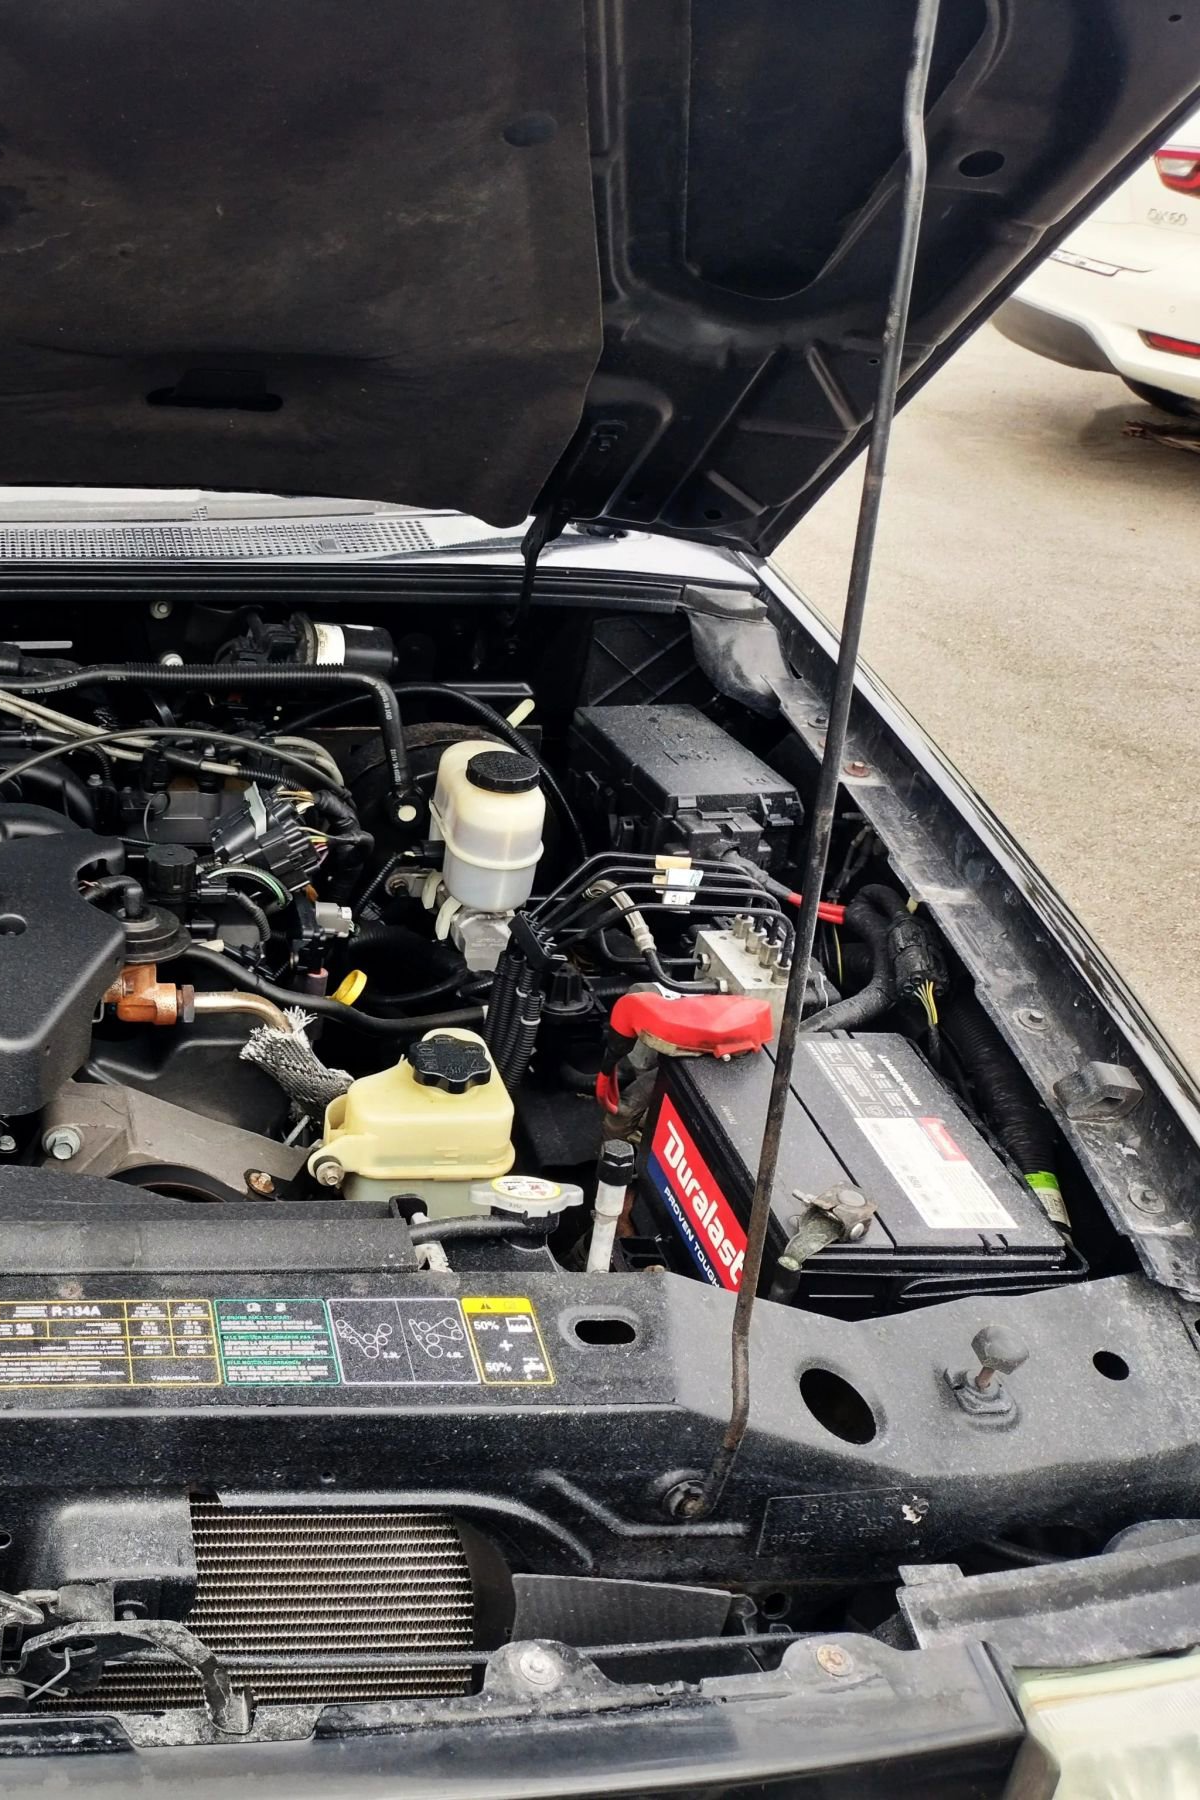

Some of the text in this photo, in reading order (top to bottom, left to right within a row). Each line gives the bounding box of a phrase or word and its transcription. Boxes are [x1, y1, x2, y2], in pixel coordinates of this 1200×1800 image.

[663, 1119, 745, 1285] Duralast
[663, 1186, 694, 1242] PROVEN
[51, 1306, 101, 1318] R-134A
[474, 1320, 499, 1331] 50%
[486, 1362, 512, 1373] 50%
